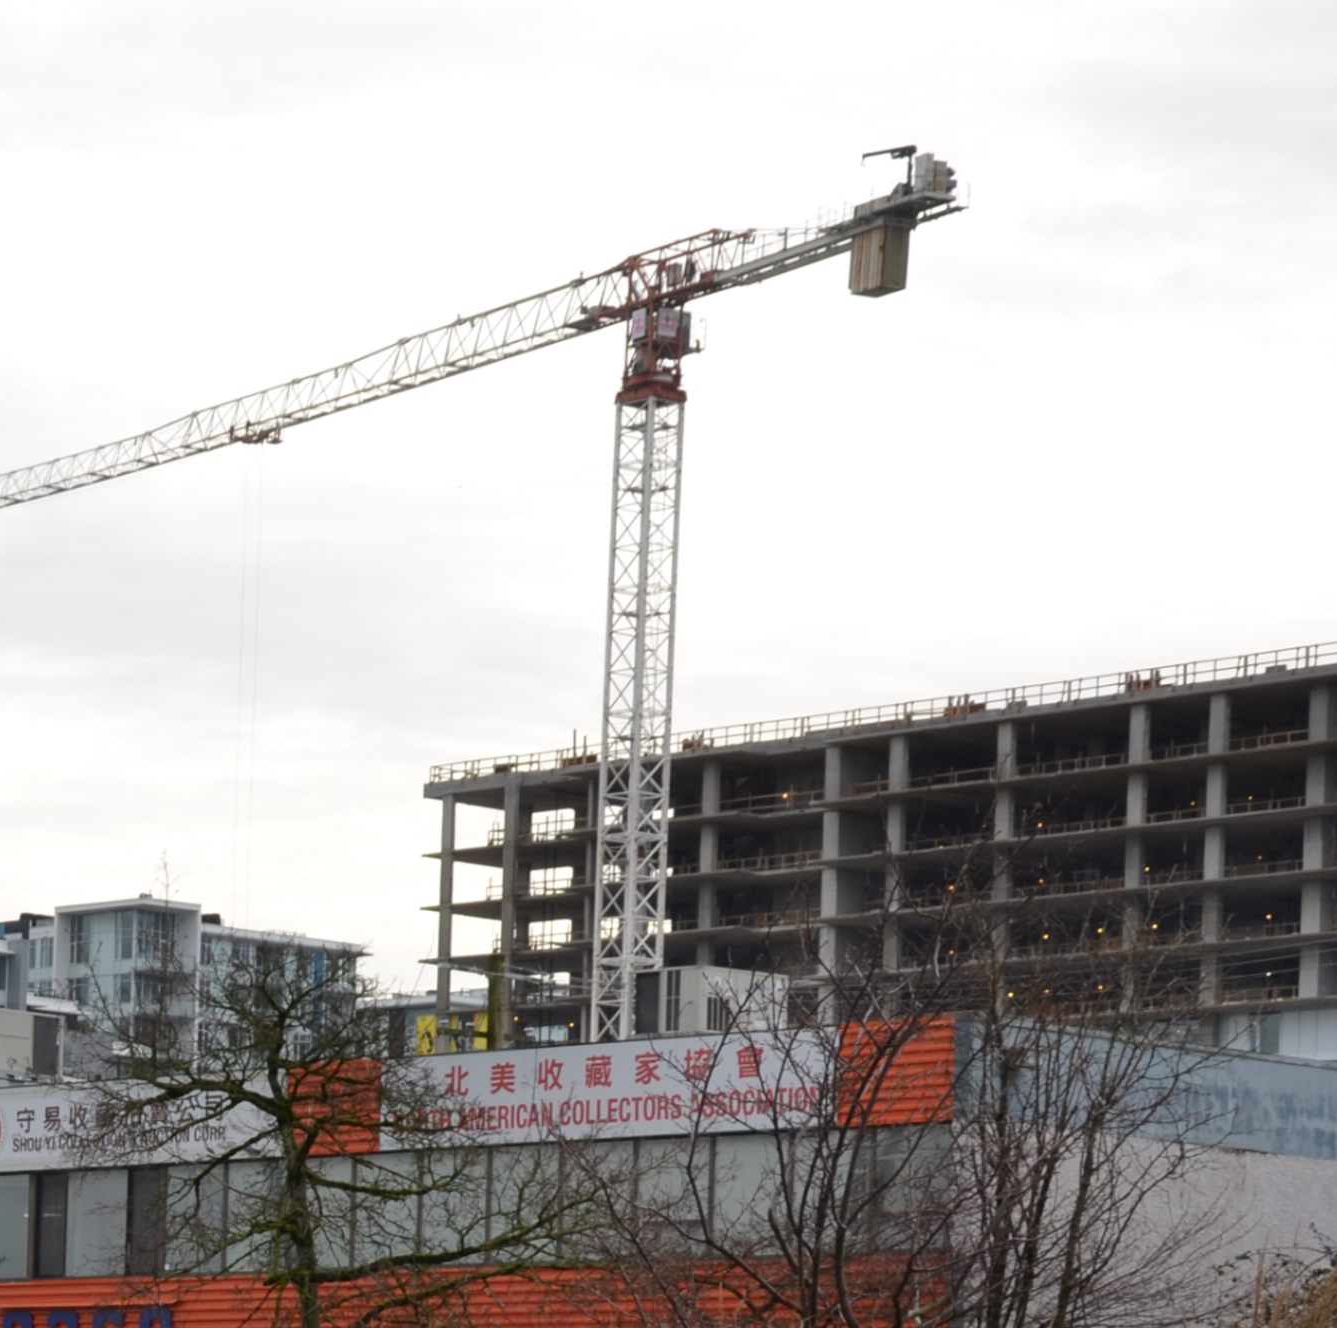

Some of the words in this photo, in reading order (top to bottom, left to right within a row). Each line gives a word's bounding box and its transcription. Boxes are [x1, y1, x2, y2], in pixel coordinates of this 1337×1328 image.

[444, 1045, 765, 1098] 北美收藏家協會
[395, 1105, 451, 1130] RTH
[457, 1101, 553, 1132] AMERICAN
[559, 1093, 682, 1127] COLLECTORS
[692, 1085, 820, 1120] ASSOCIATION
[12, 1133, 41, 1153] SHOU
[45, 1135, 55, 1151] YI
[58, 1130, 126, 1151] COLLION
